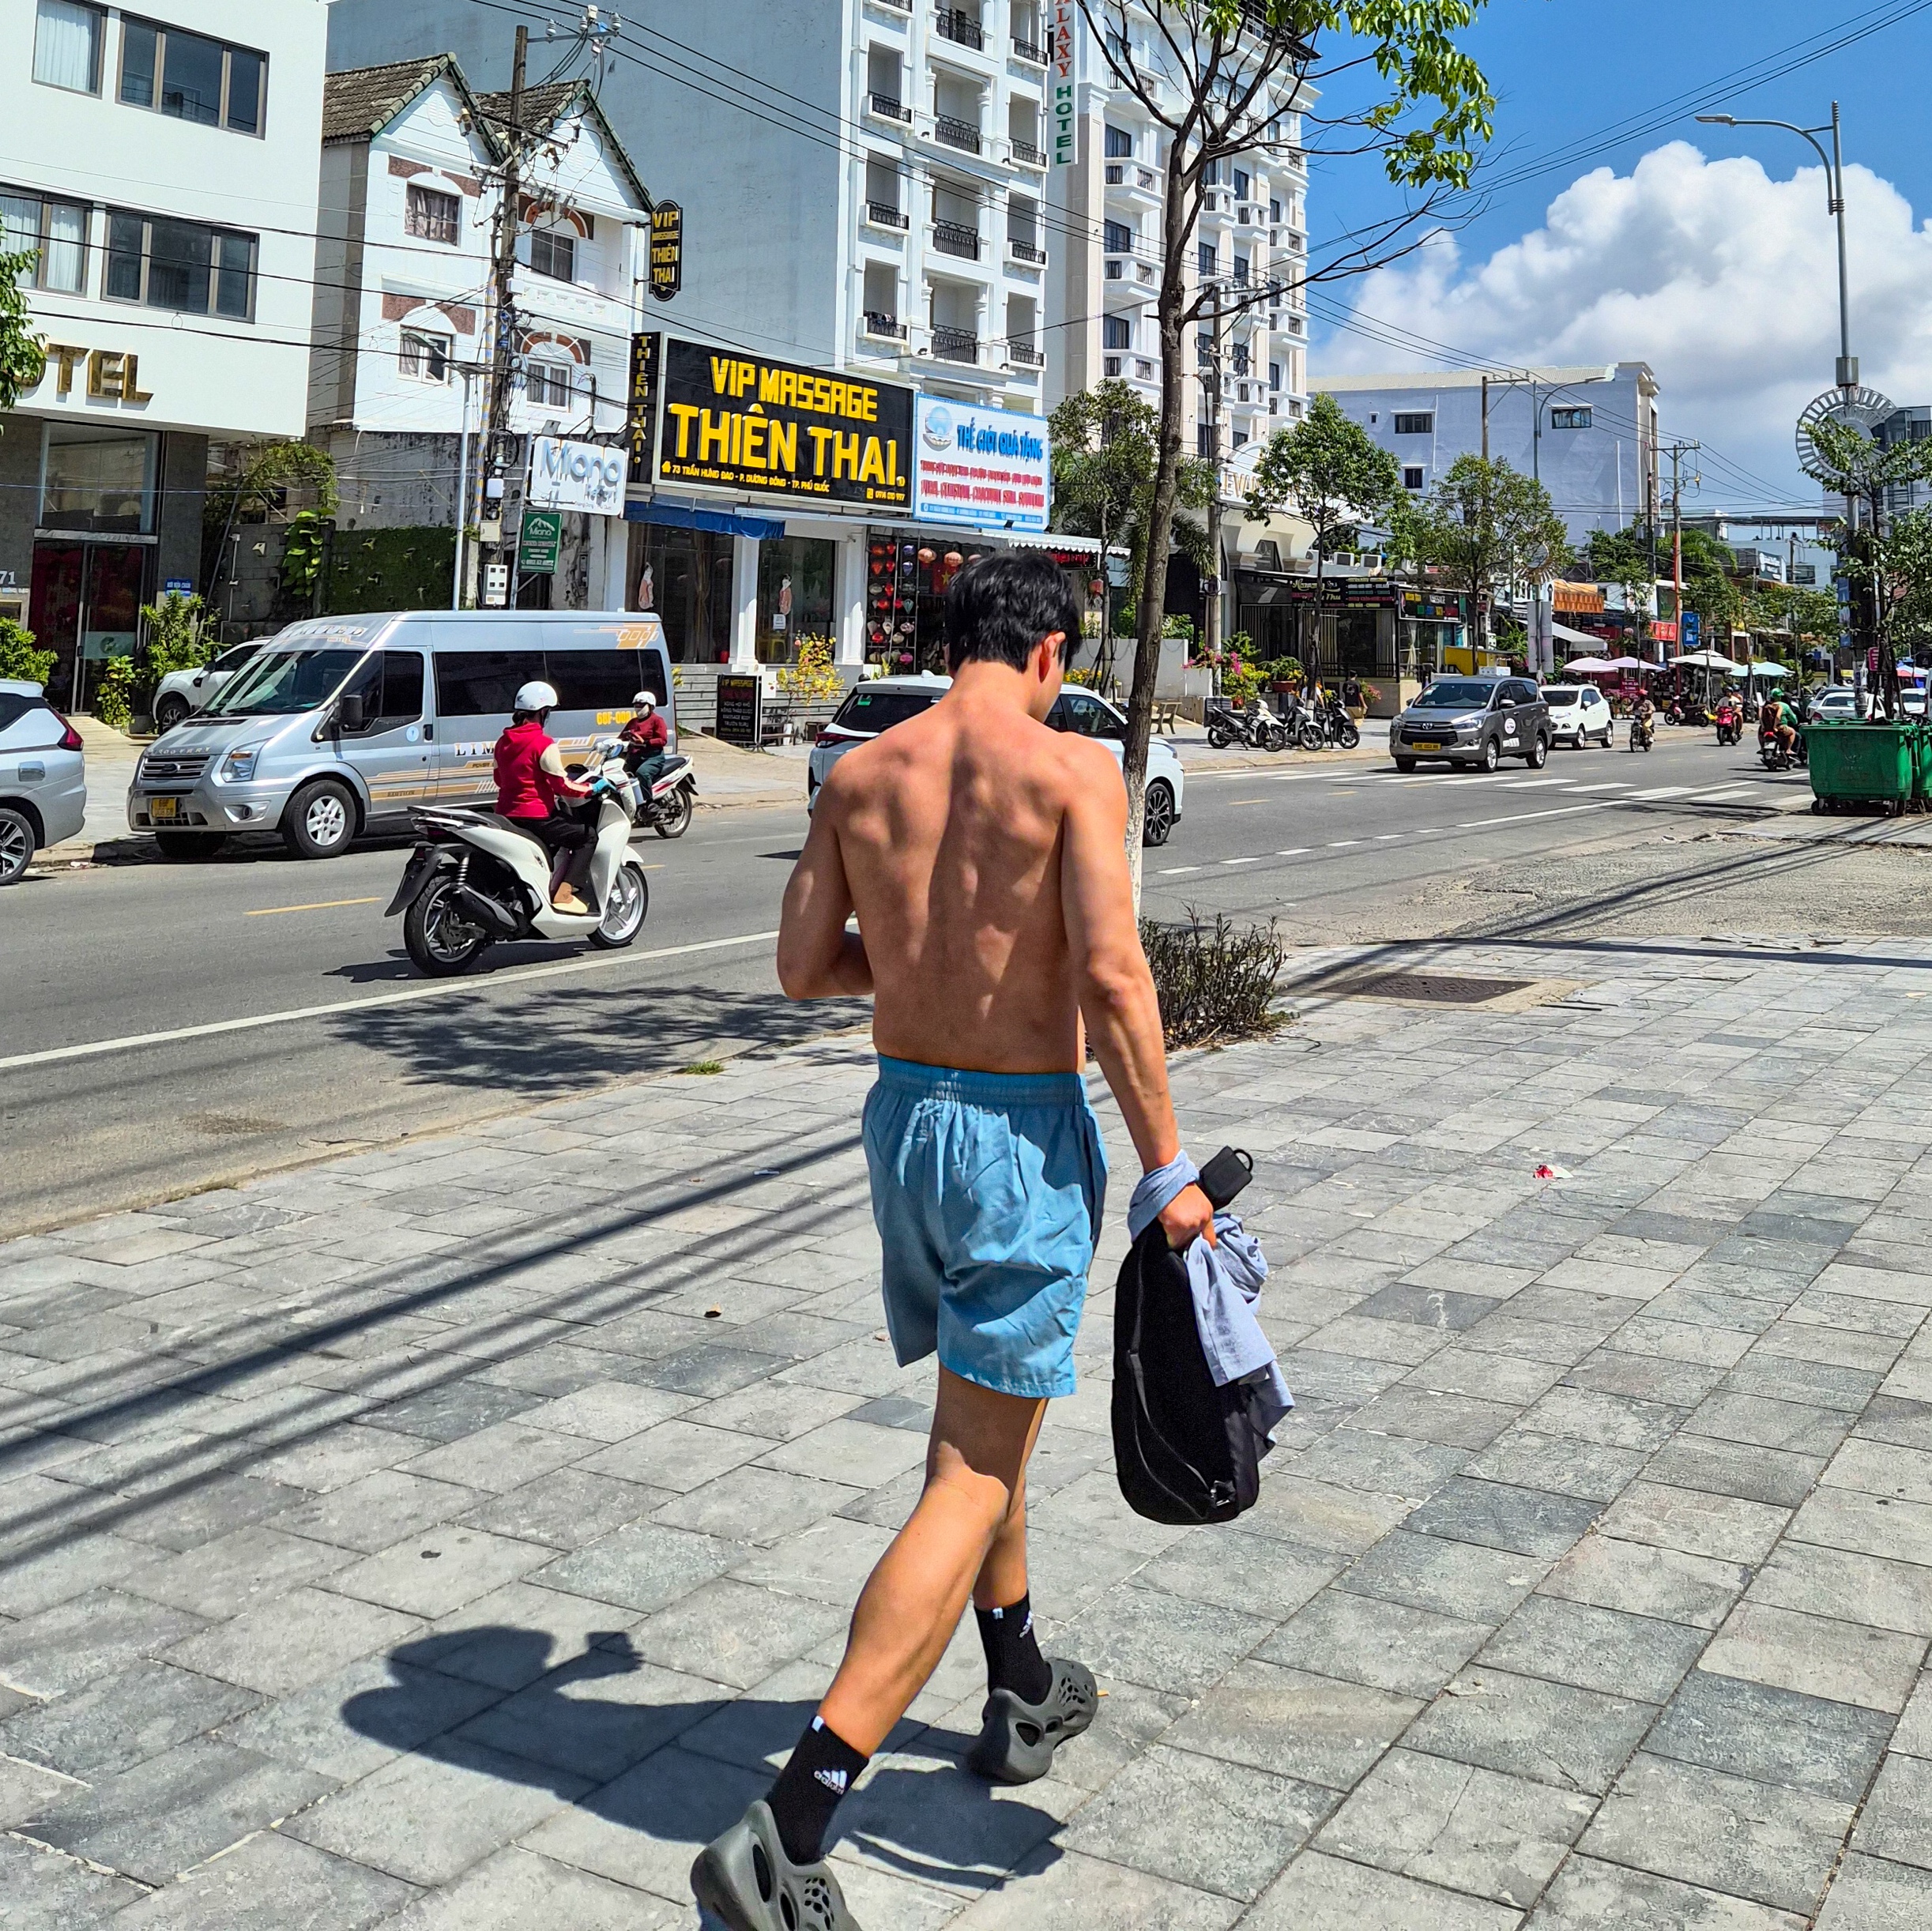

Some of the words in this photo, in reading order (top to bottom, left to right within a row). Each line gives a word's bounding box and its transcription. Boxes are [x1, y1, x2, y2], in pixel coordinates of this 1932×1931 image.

[1056, 85, 1073, 165] HOTEL
[653, 211, 679, 228] VIP
[652, 243, 678, 263] THIÊN
[653, 266, 675, 283] THAI
[635, 336, 653, 397] THIÊN
[710, 356, 756, 397] VIP
[758, 366, 879, 422] MASSAGE
[668, 403, 798, 472] THIÊN
[957, 416, 976, 453] THẾ
[976, 424, 997, 456] GIỚI
[541, 439, 622, 486] Miana
[672, 465, 681, 474] 73
[801, 479, 813, 491] PHÚ
[529, 526, 552, 536] Miana
